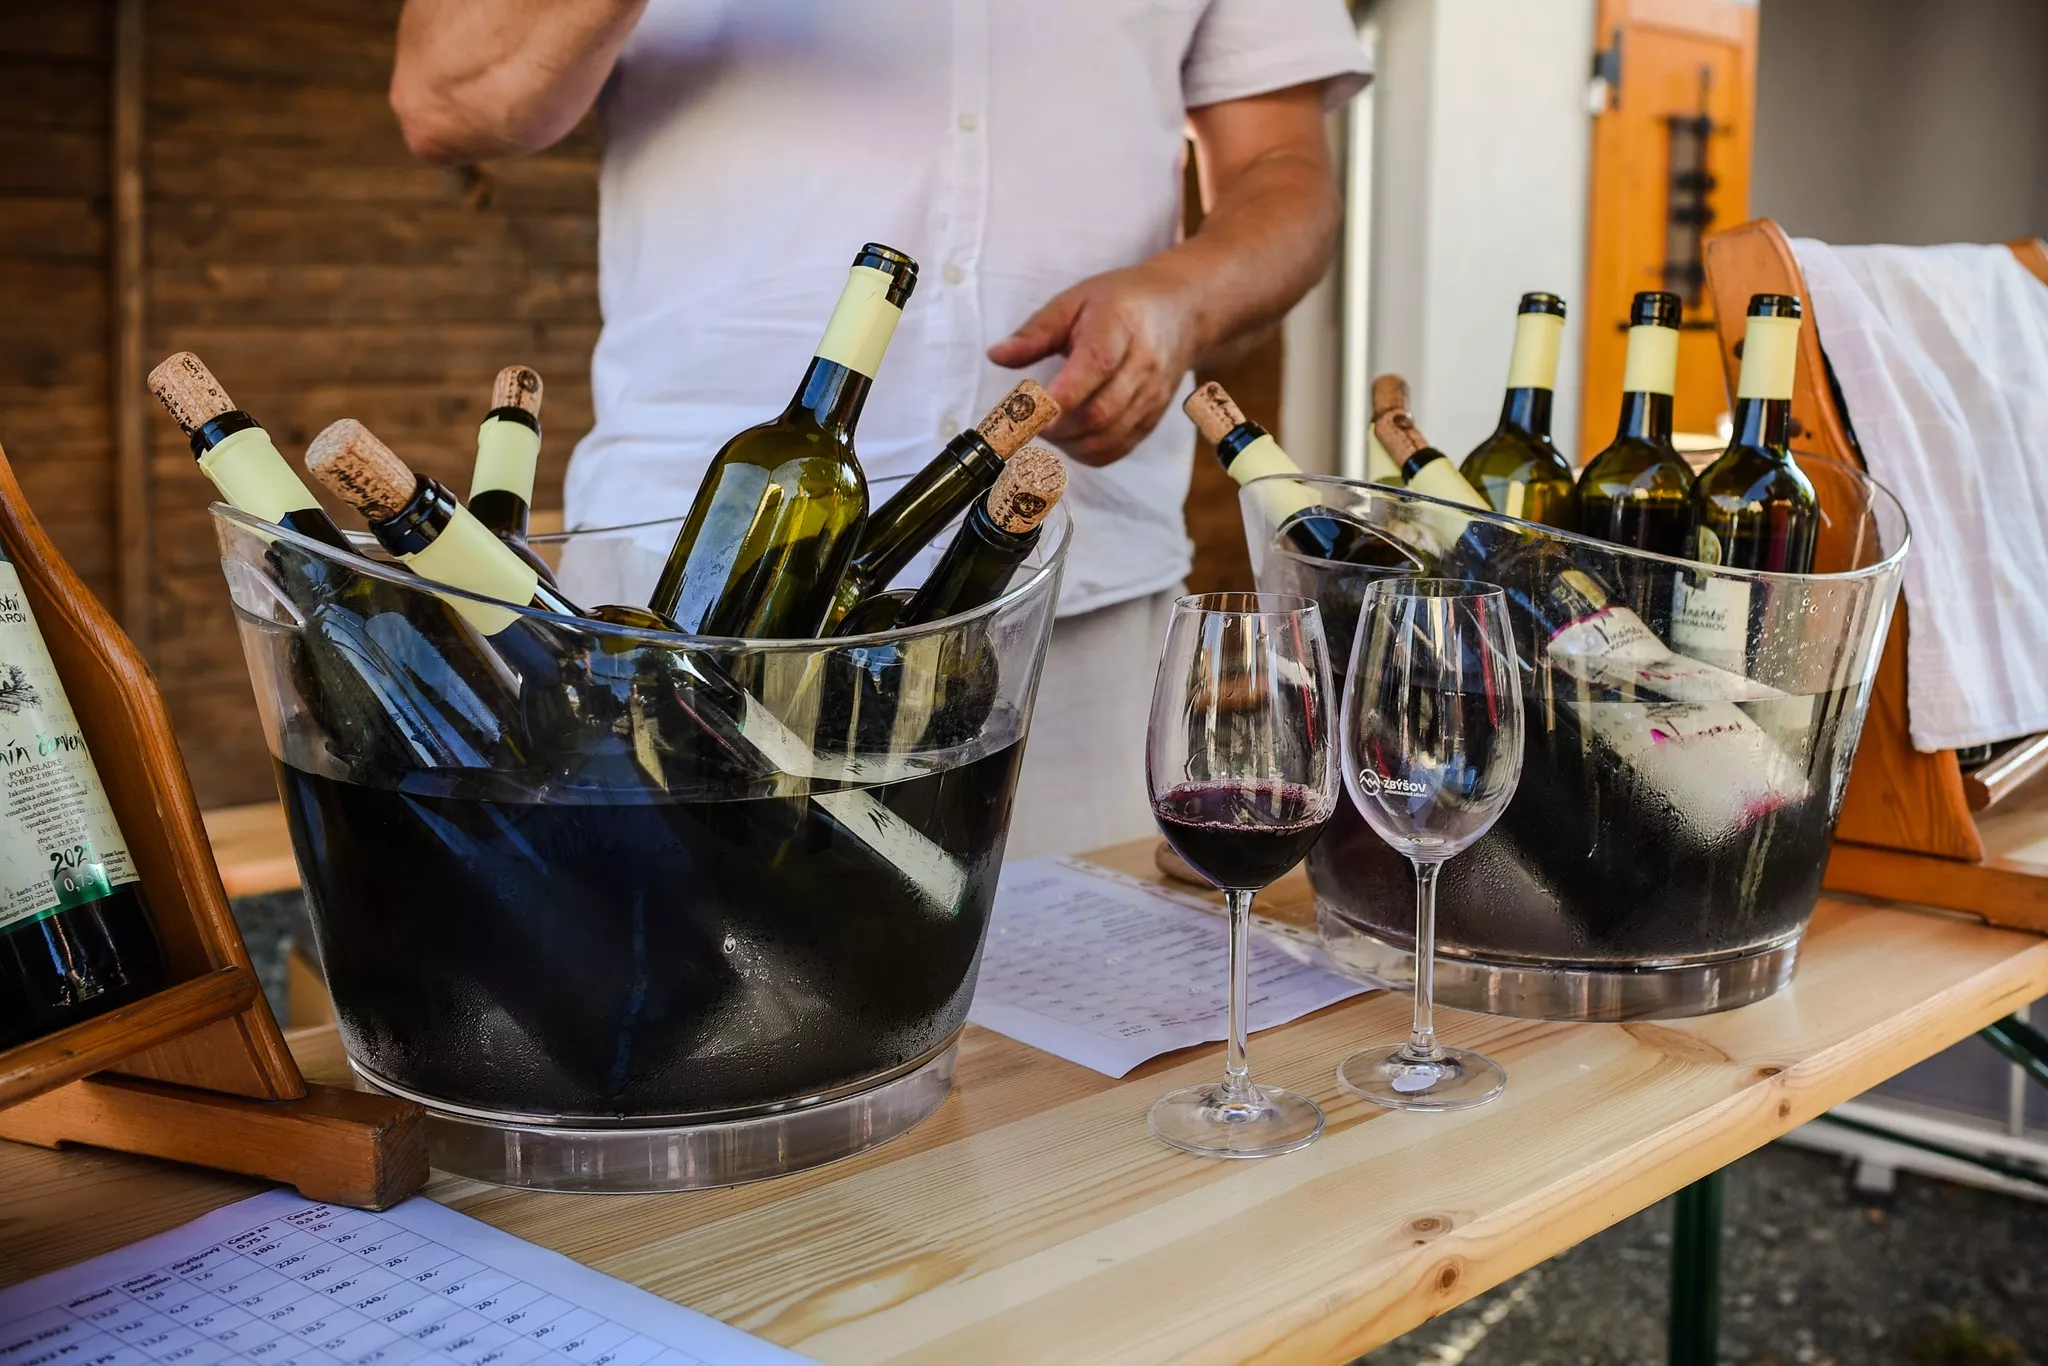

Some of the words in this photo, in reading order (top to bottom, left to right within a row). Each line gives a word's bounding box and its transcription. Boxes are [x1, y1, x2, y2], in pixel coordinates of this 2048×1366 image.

[8, 757, 63, 779] POLOSLADKÉ
[7, 774, 35, 788] VÝBĚR
[36, 773, 42, 781] Z
[54, 782, 80, 793] MORAVA
[1383, 778, 1427, 793] ZBÝŠOV
[8, 784, 35, 799] Jakostní
[35, 781, 50, 789] víno
[32, 880, 50, 890] TR21
[63, 873, 94, 892] 0,75
[286, 1210, 314, 1221] Cena
[295, 1217, 314, 1225] 0,5
[227, 1232, 256, 1245] Cena
[236, 1236, 261, 1250] 0,75
[251, 1242, 282, 1256] 180,-
[310, 1222, 333, 1232] 20,-
[172, 1246, 220, 1270] zbytkový
[219, 1284, 238, 1294] 1,6
[274, 1254, 307, 1269] 220,-
[334, 1233, 358, 1243] 20,-
[180, 1263, 204, 1274] cukr
[242, 1296, 263, 1307] 3,2
[300, 1266, 332, 1281] 220,-
[360, 1244, 383, 1255] 20,-
[122, 1273, 157, 1288] obsah
[129, 1277, 172, 1293] kyselin
[268, 1306, 295, 1320] 20,9
[325, 1279, 358, 1294] 240,-
[385, 1256, 409, 1267] 20,-
[68, 1289, 113, 1308] alkohol
[299, 1322, 326, 1336] 18,5
[356, 1293, 388, 1309] 240,-
[415, 1270, 440, 1282] 20,-
[382, 1307, 415, 1323] 220,-
[442, 1283, 467, 1295] 20,-
[474, 1298, 499, 1311] 20,-
[503, 1311, 527, 1325] 20,-
[531, 1325, 556, 1338] 20,-
[562, 1338, 586, 1353] 20,-
